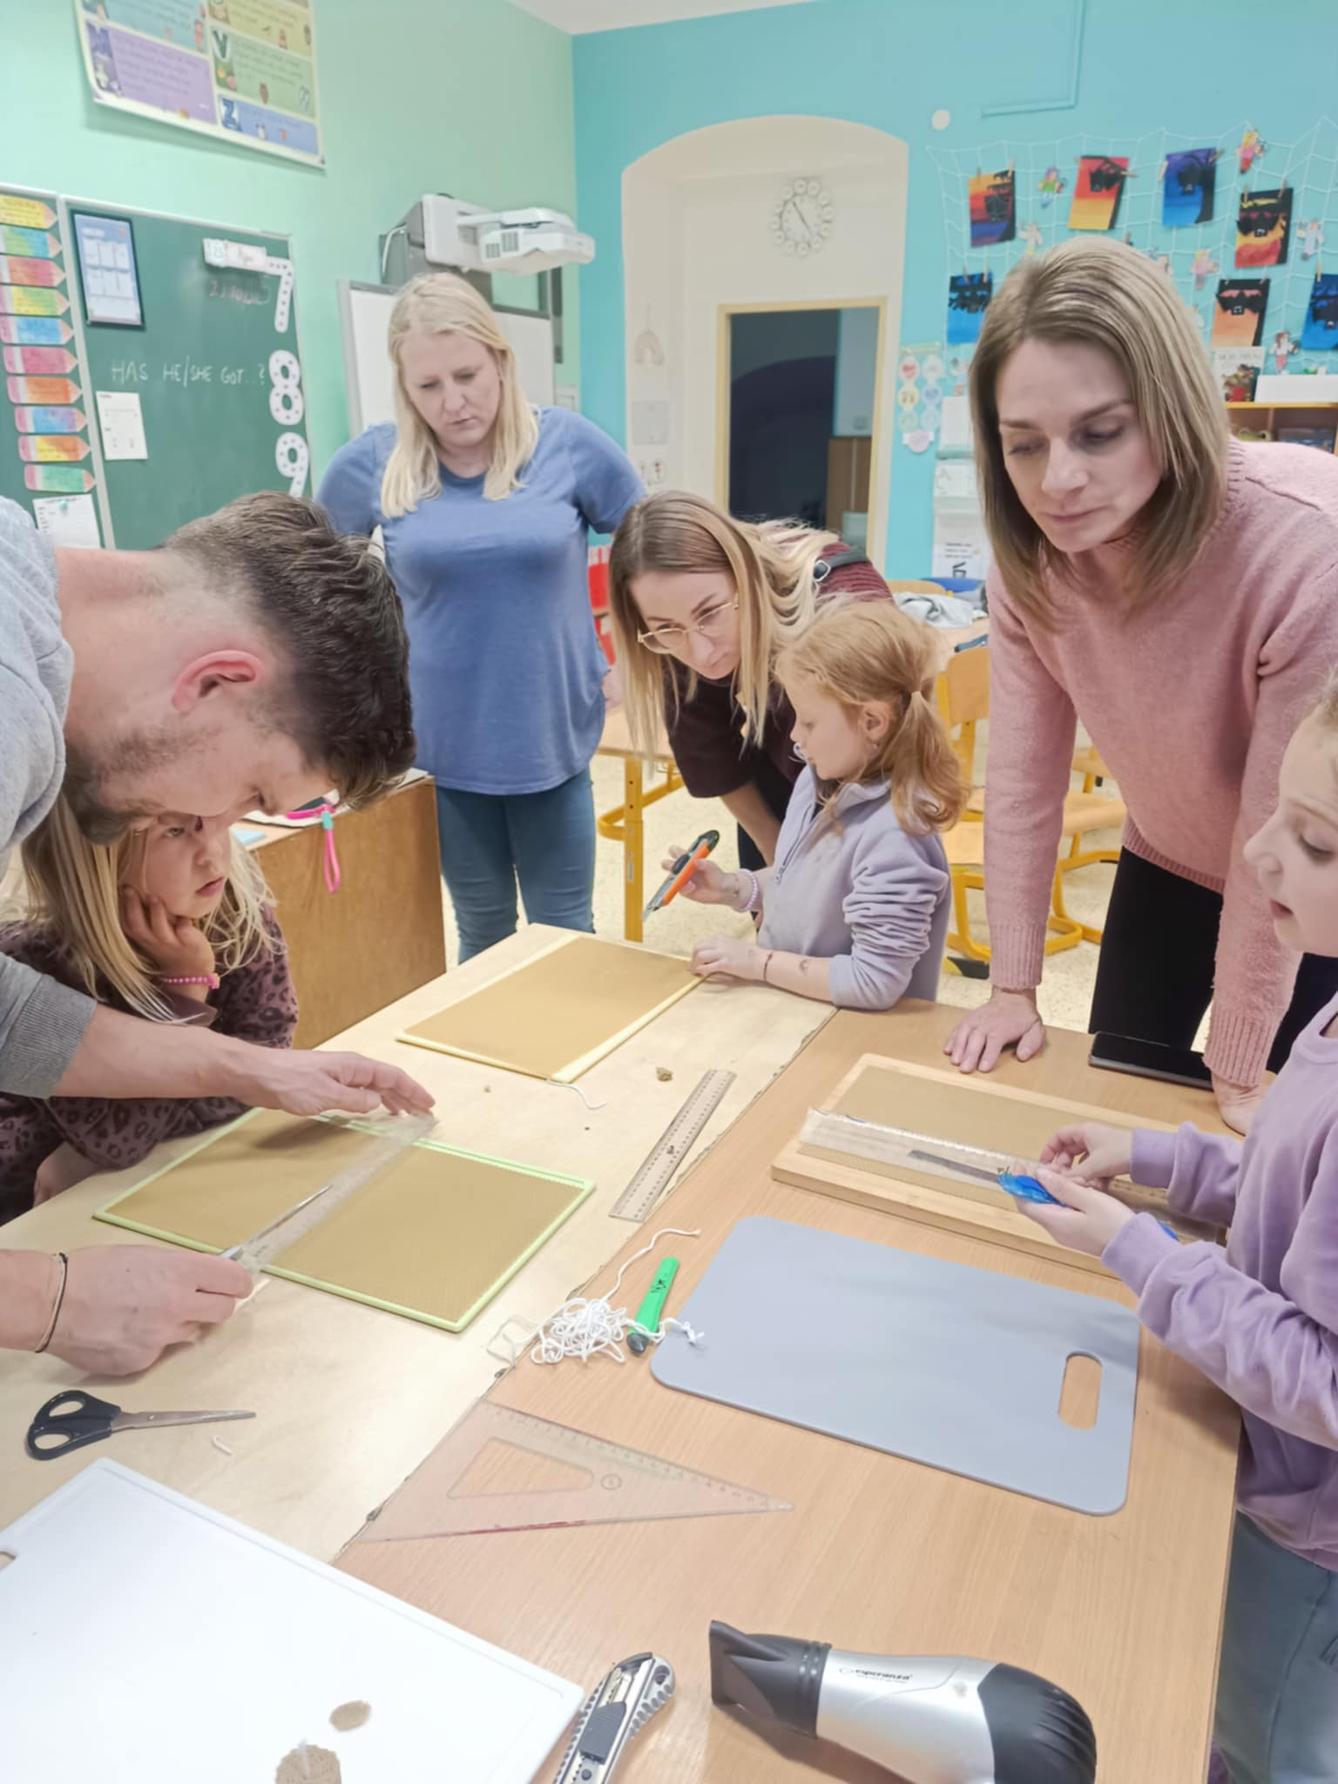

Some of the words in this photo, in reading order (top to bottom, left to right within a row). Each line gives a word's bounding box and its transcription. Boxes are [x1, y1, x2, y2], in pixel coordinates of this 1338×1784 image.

[211, 29, 228, 59] V
[265, 255, 294, 333] 7
[111, 360, 149, 385] HAS
[162, 354, 213, 388] HE/SHE
[268, 349, 304, 426] 8
[275, 431, 309, 499] 9
